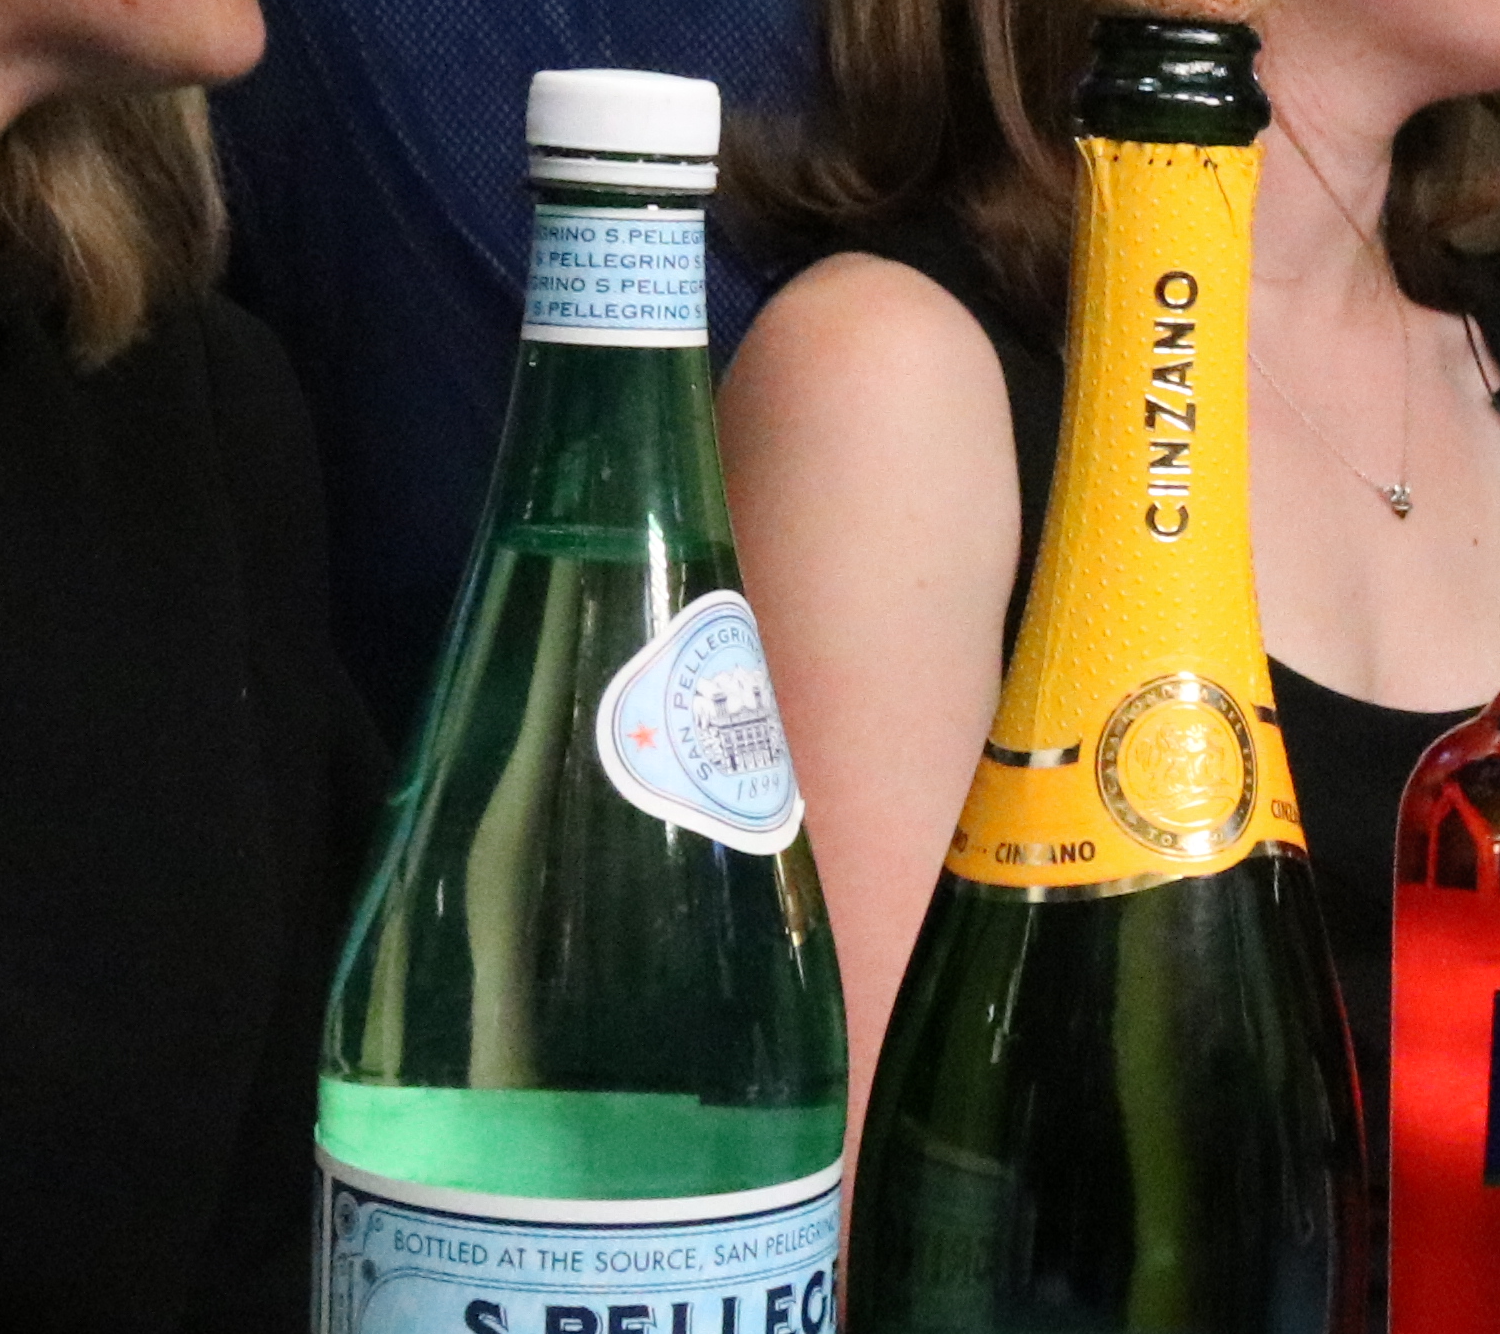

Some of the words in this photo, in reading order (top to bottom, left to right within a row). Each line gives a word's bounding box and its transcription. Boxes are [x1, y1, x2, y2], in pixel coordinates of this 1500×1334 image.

[1143, 269, 1199, 544] CINZANO
[680, 726, 715, 782] SAN
[393, 1229, 489, 1267] BOTTLED
[499, 1247, 527, 1270] AT
[537, 1249, 584, 1274] THE
[594, 1246, 704, 1276] SOURCE,
[712, 1239, 759, 1267] SAN
